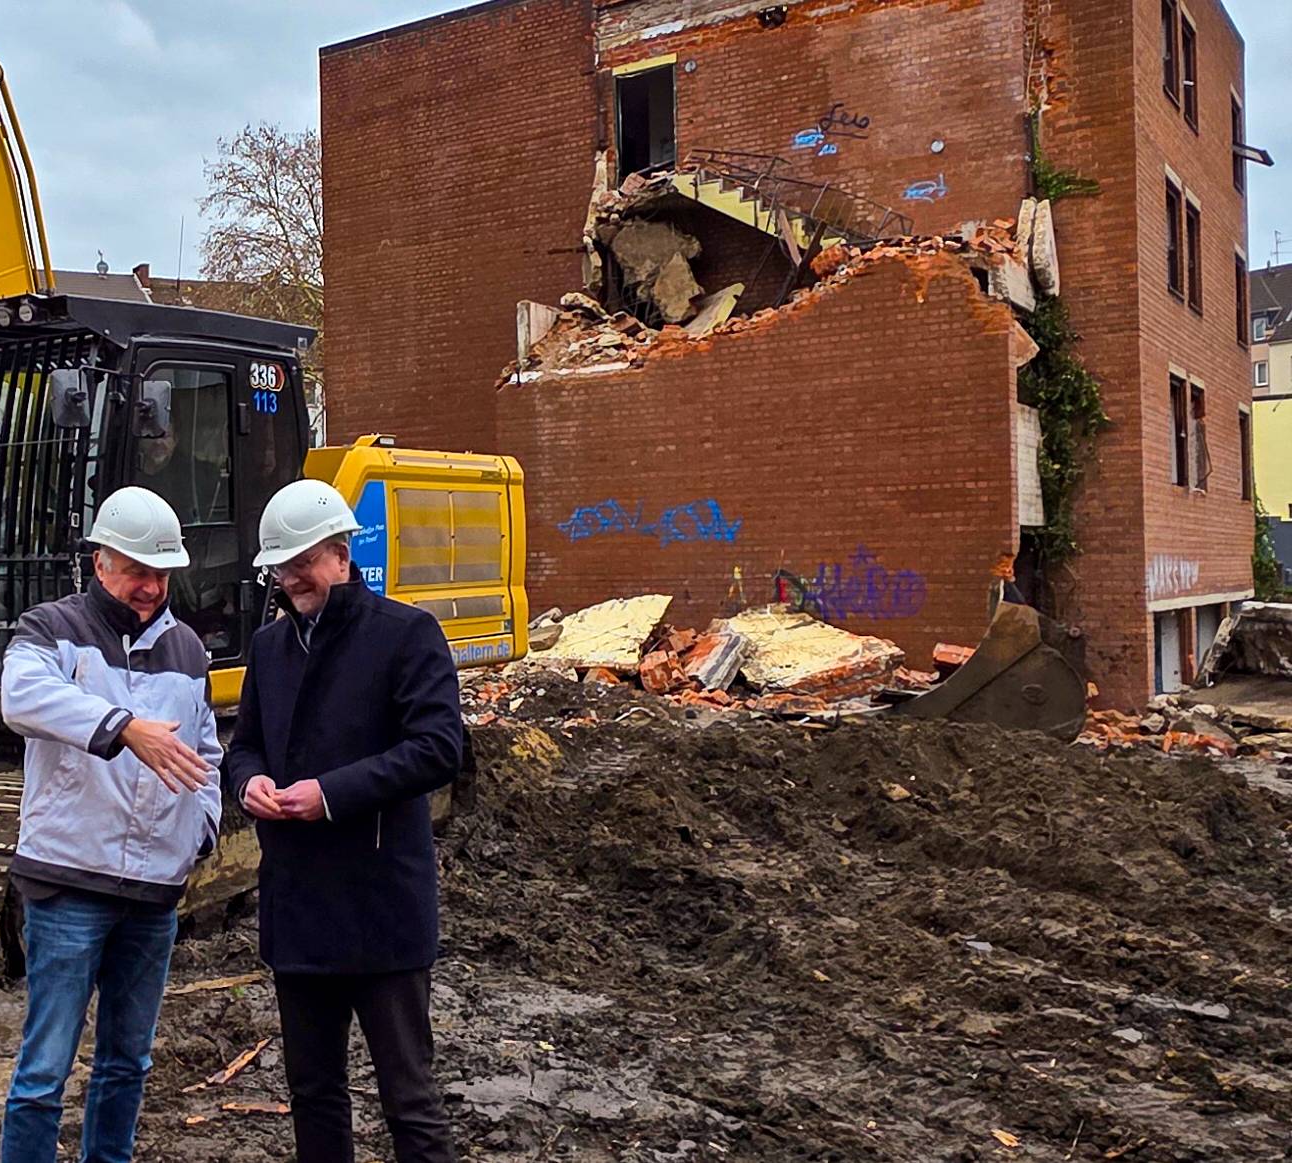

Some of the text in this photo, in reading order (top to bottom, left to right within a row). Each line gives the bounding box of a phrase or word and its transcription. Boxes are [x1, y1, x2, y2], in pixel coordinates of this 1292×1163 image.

[249, 362, 277, 388] 336
[253, 391, 278, 413] 113
[256, 565, 269, 587] Po
[359, 566, 384, 582] TER
[452, 640, 511, 663] haltern.de
